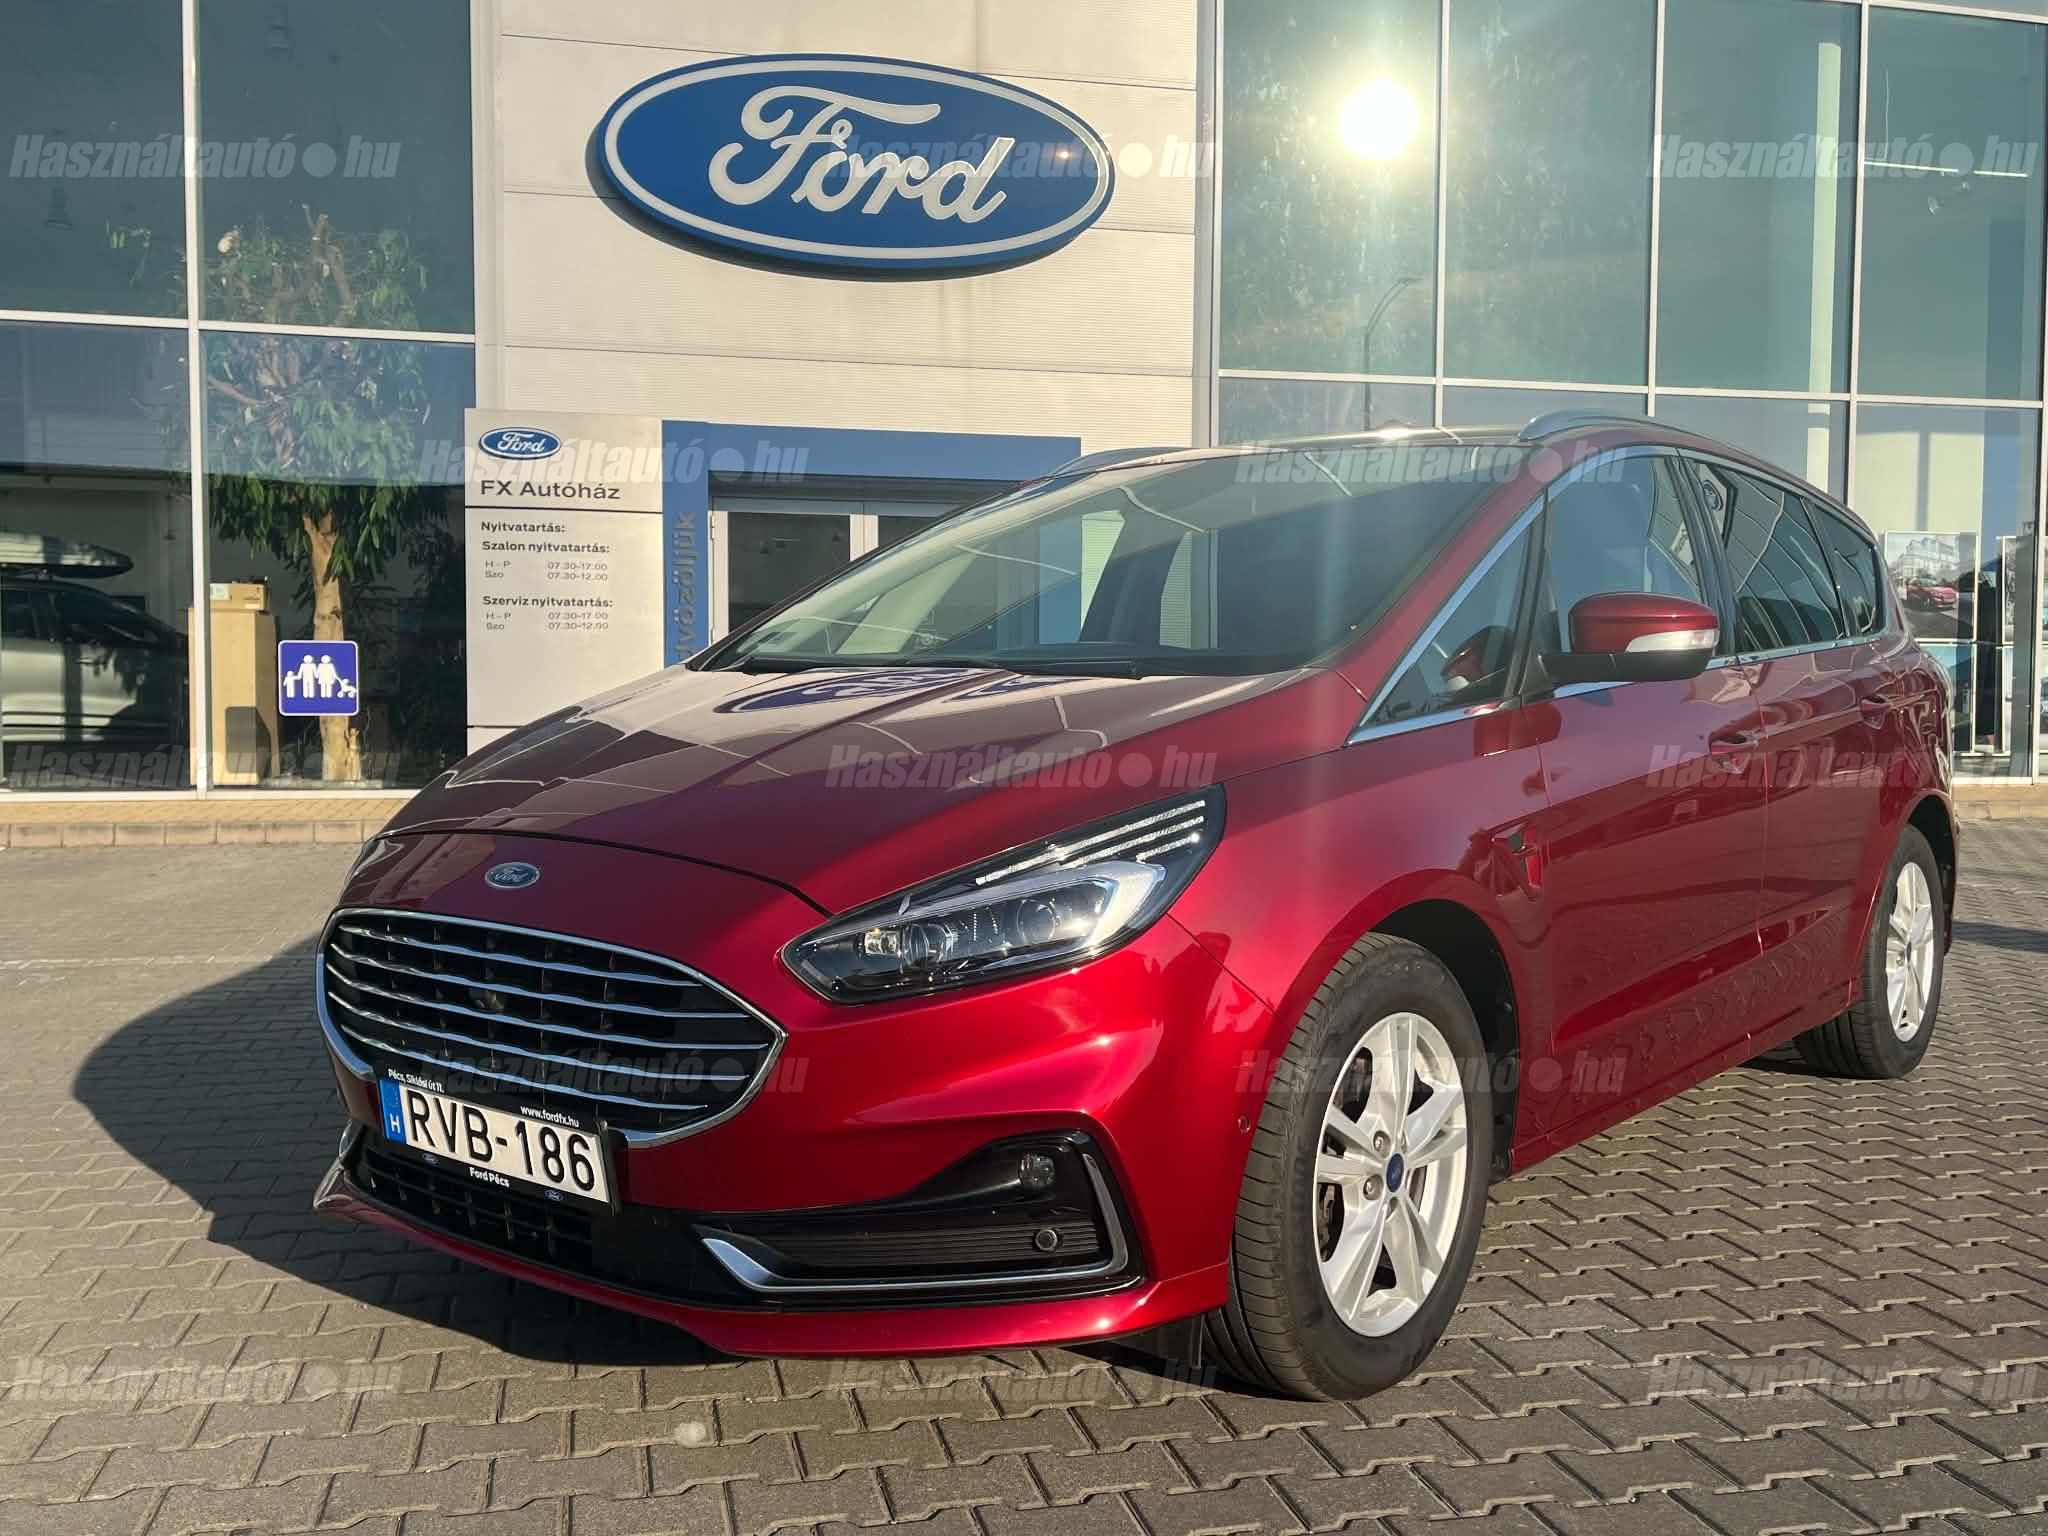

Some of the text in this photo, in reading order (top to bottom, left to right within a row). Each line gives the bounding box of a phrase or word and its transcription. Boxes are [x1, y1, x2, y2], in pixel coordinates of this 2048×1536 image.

[708, 85, 1015, 224] Ford
[497, 431, 546, 453] Ford
[480, 480, 621, 500] FX Autóház
[481, 521, 566, 533] Nyitvatartás:
[482, 541, 610, 553] Szalon nyitvatartás:
[672, 512, 701, 661] dvözöljük
[482, 595, 613, 608] Szerviz nyitvatartás:
[390, 1113, 401, 1134] H
[520, 1105, 580, 1128] www.fordfx.hu
[406, 1089, 595, 1192] RVB-186
[469, 1167, 510, 1189] Ford Pécs
